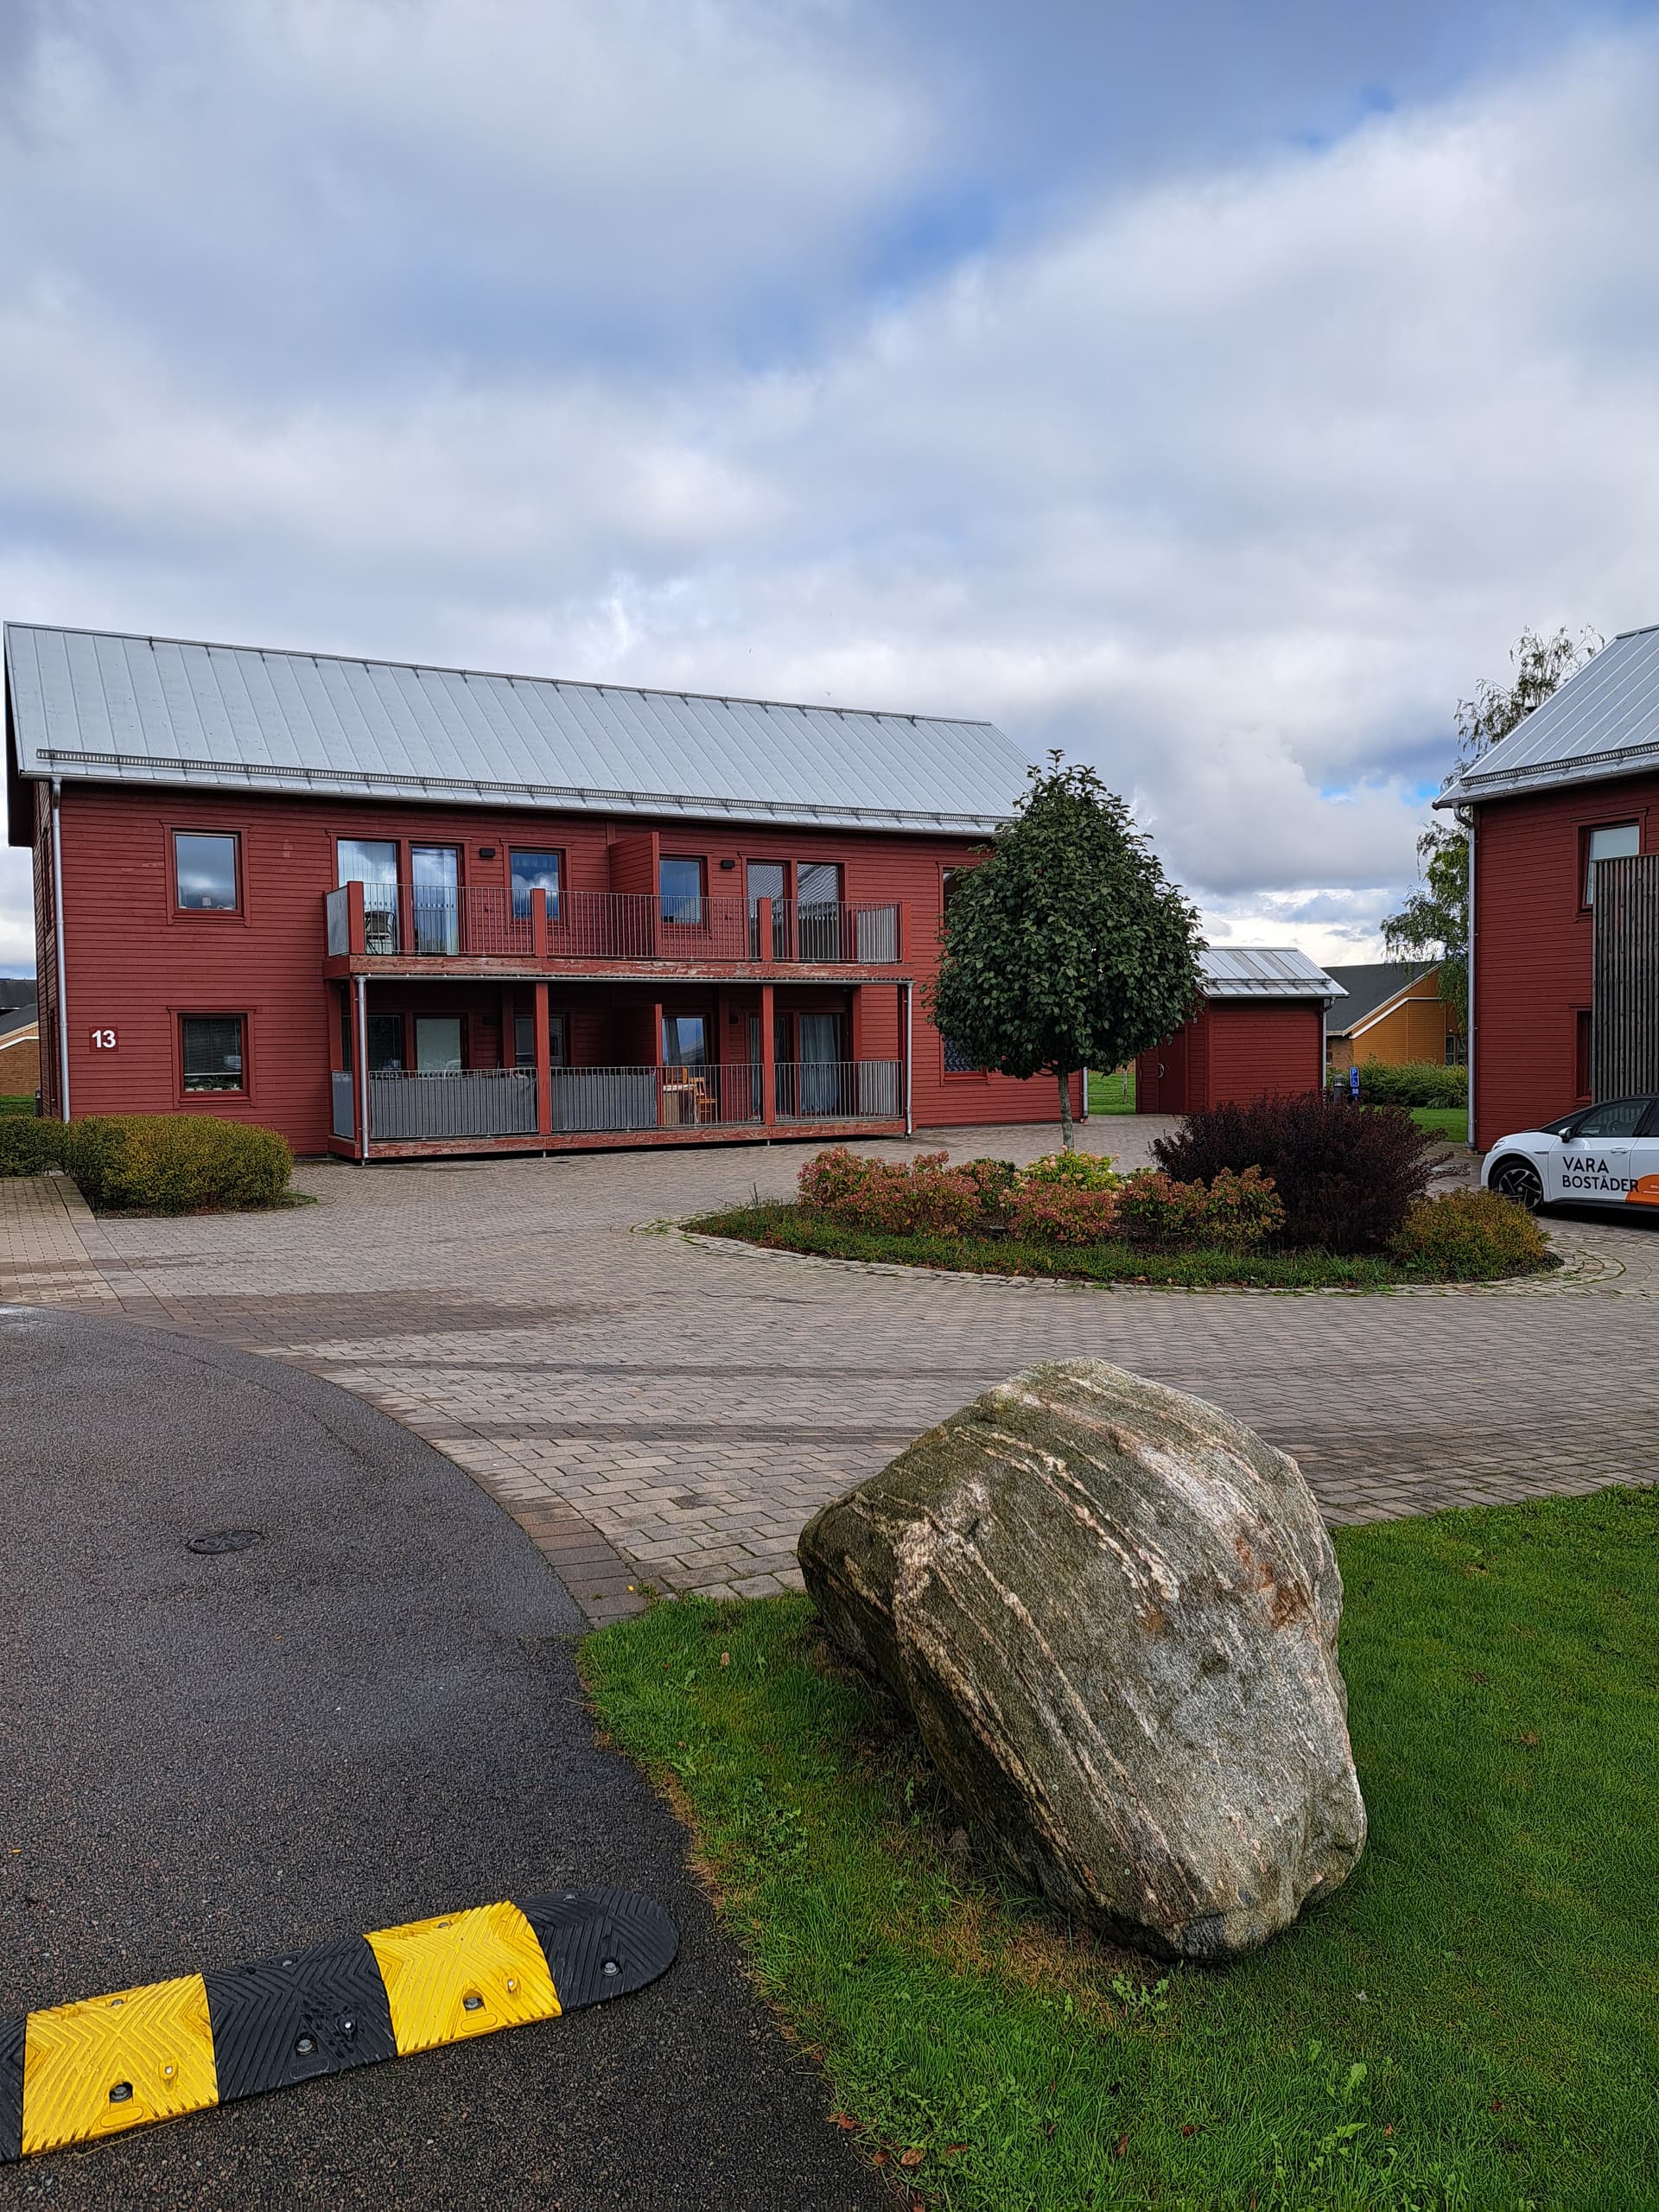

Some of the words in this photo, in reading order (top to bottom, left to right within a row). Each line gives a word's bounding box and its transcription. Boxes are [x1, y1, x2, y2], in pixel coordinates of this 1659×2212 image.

[92, 1029, 116, 1048] 13
[1562, 1156, 1609, 1173] VARA
[1562, 1174, 1639, 1192] BOSTÄDER
